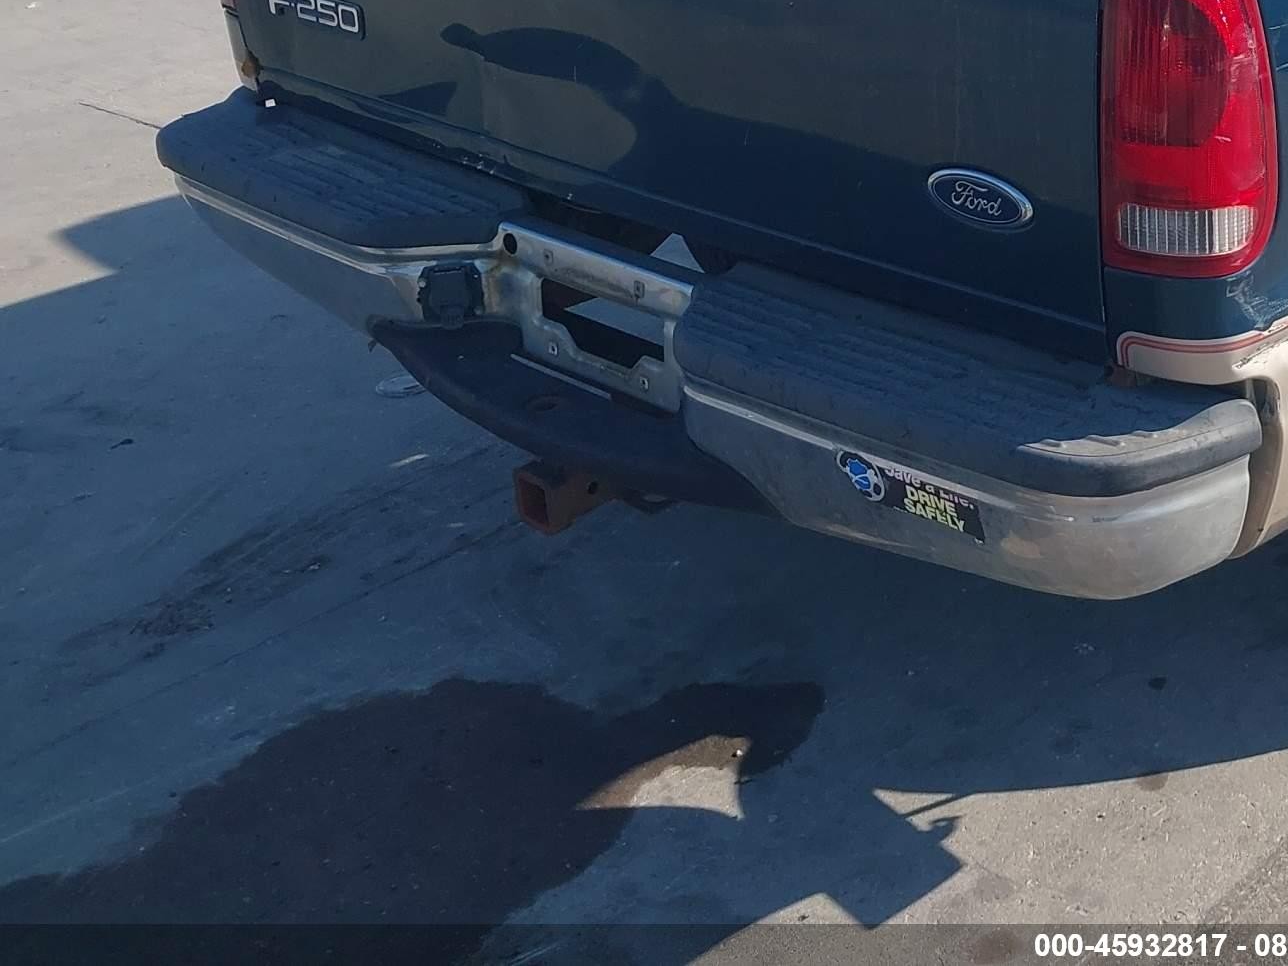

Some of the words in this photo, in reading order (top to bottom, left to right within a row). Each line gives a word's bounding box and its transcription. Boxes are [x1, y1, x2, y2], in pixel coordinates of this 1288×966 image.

[951, 180, 1002, 216] Ford
[903, 497, 965, 532] SAFELY
[905, 484, 958, 517] DRIVE
